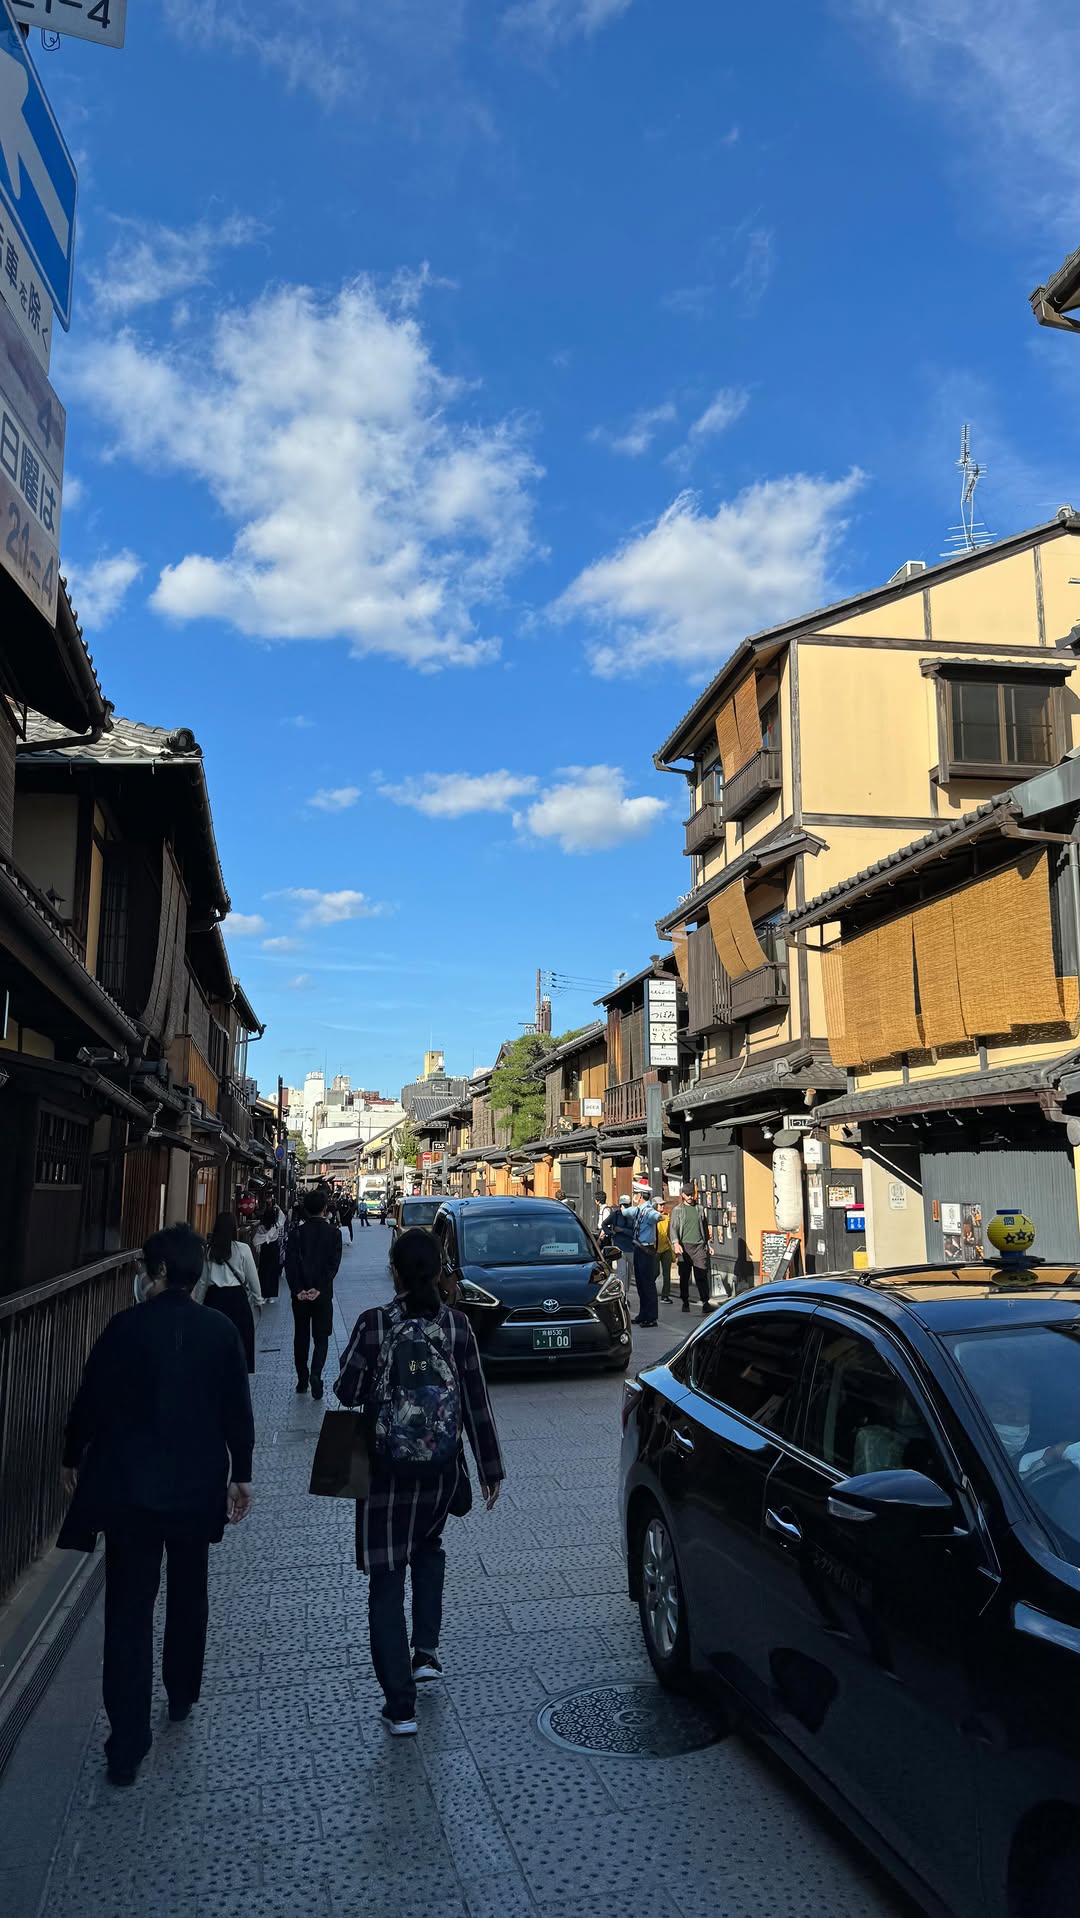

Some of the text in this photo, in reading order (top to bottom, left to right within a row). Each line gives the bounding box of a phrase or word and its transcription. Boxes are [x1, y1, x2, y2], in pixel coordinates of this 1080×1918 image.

[0, 411, 57, 538] 日曜は
[651, 1010, 675, 1018] つぼみ
